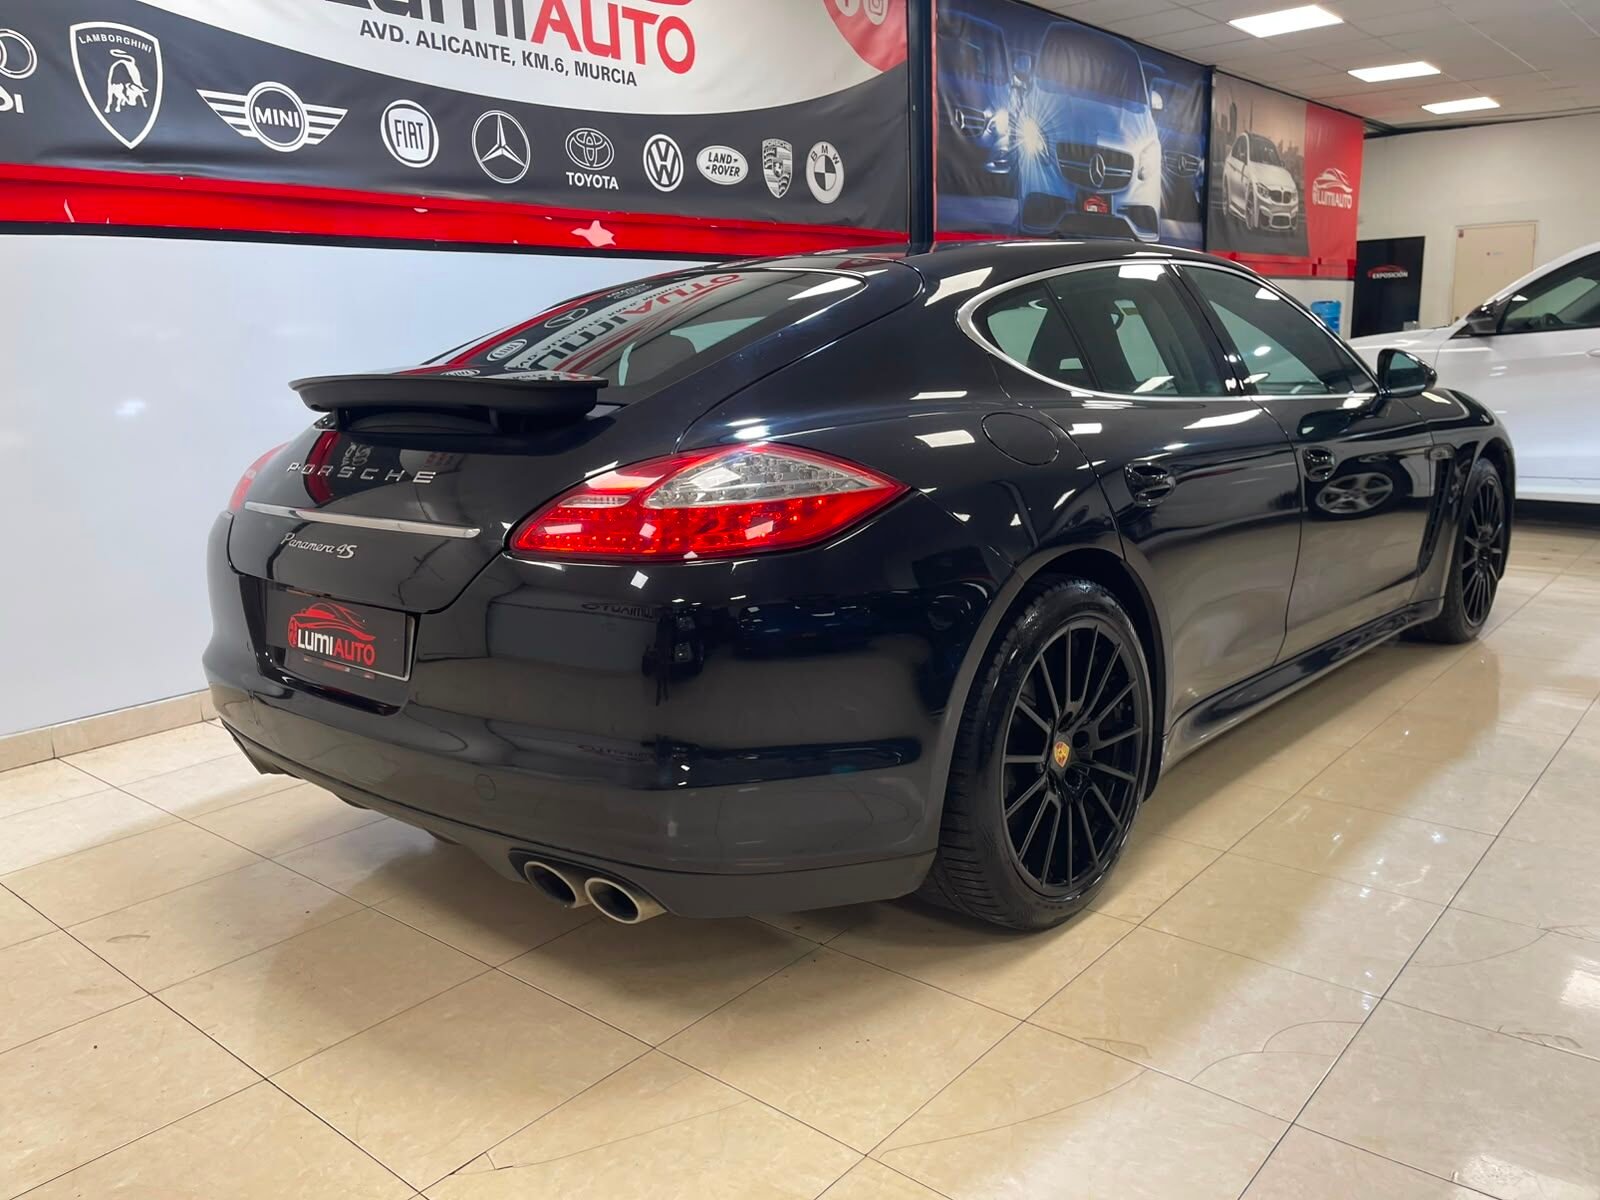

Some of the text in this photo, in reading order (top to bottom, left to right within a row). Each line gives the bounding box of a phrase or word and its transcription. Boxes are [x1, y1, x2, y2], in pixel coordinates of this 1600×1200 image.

[78, 33, 152, 53] LAMBORGHINI
[360, 19, 637, 86] AVD. ALICANTE, KM.6, MURCIA
[254, 106, 300, 128] MINI
[393, 119, 424, 150] FIAT
[565, 171, 619, 190] TOYOTA
[286, 462, 437, 484] PORSCHE
[280, 532, 358, 559] Panamera 4S
[297, 629, 376, 666] LUMIAUTO
